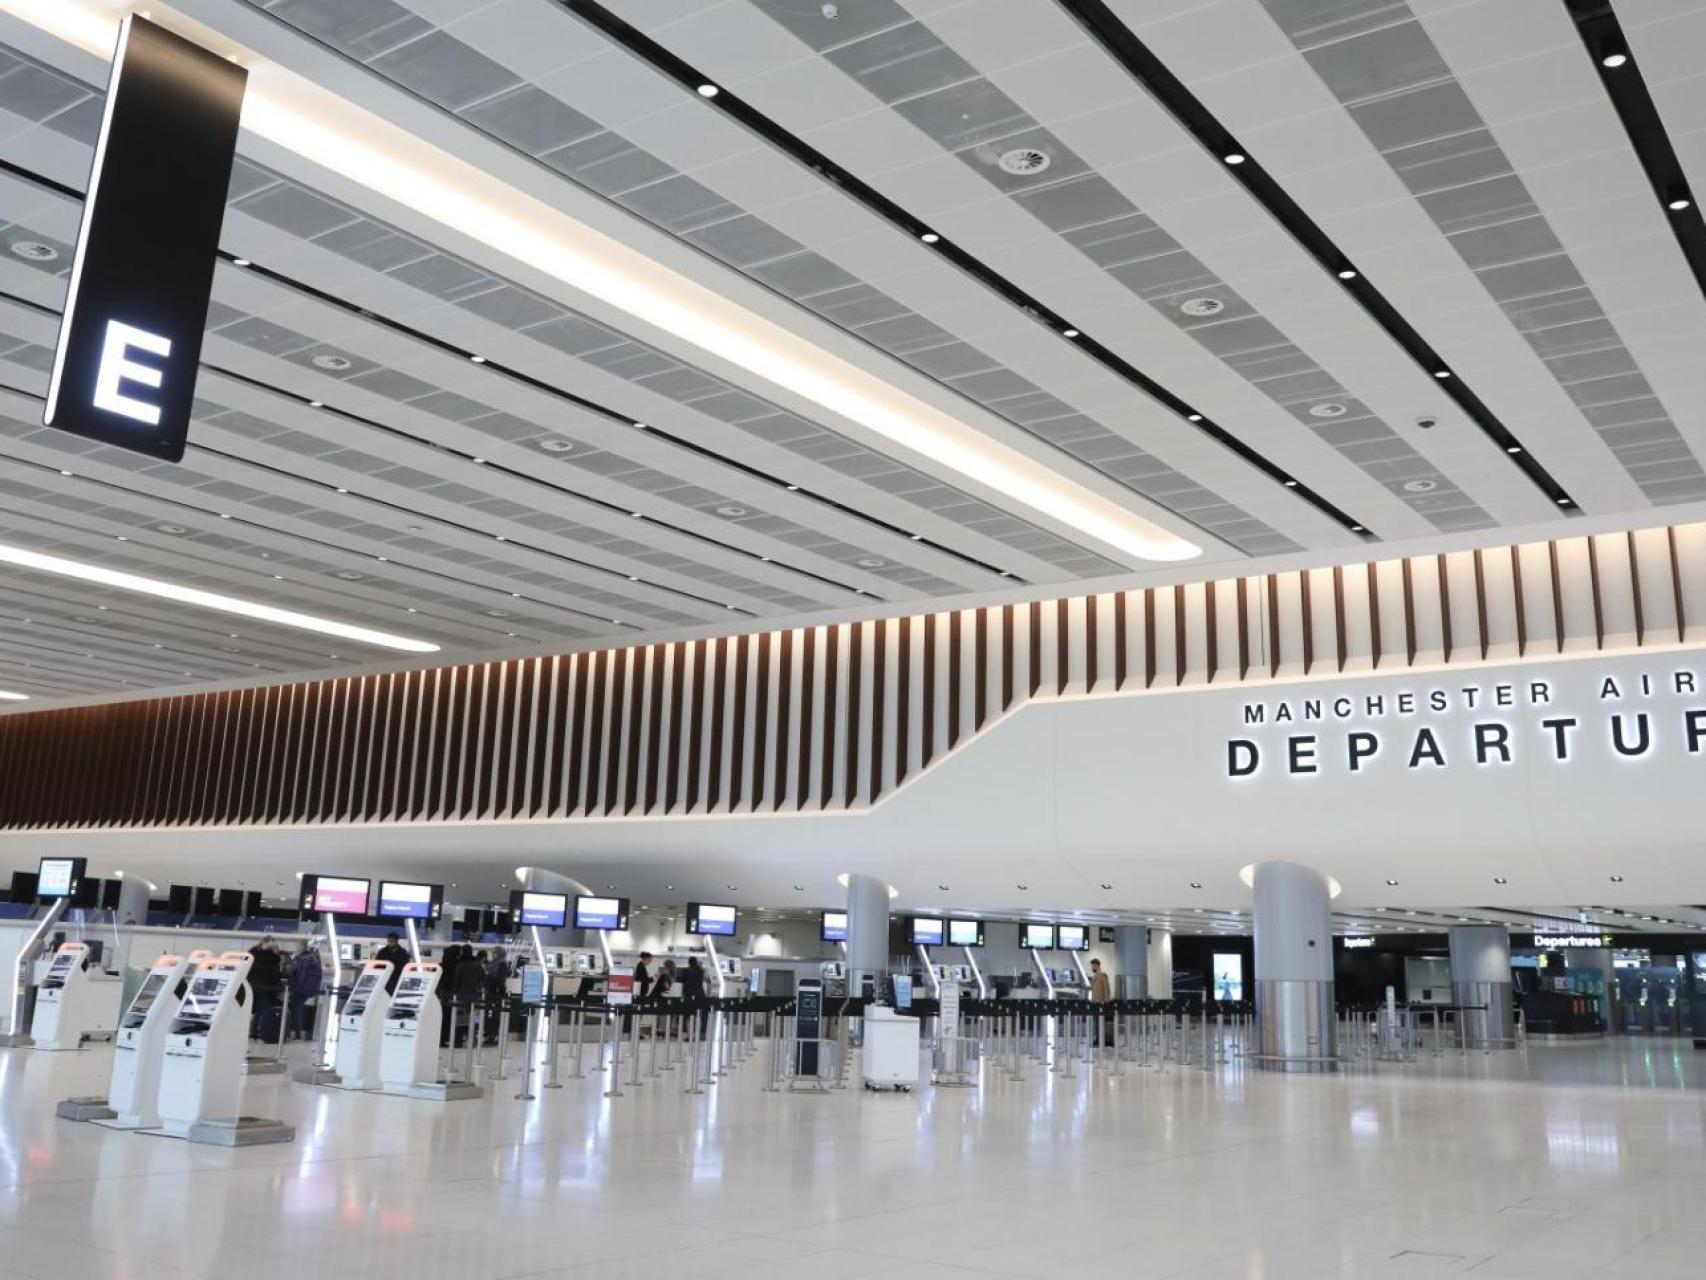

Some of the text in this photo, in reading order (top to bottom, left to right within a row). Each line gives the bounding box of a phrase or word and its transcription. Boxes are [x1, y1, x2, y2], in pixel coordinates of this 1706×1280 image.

[93, 319, 172, 425] E
[1244, 672, 1695, 724] MANCHESTER AIR
[1534, 934, 1602, 951] Departures
